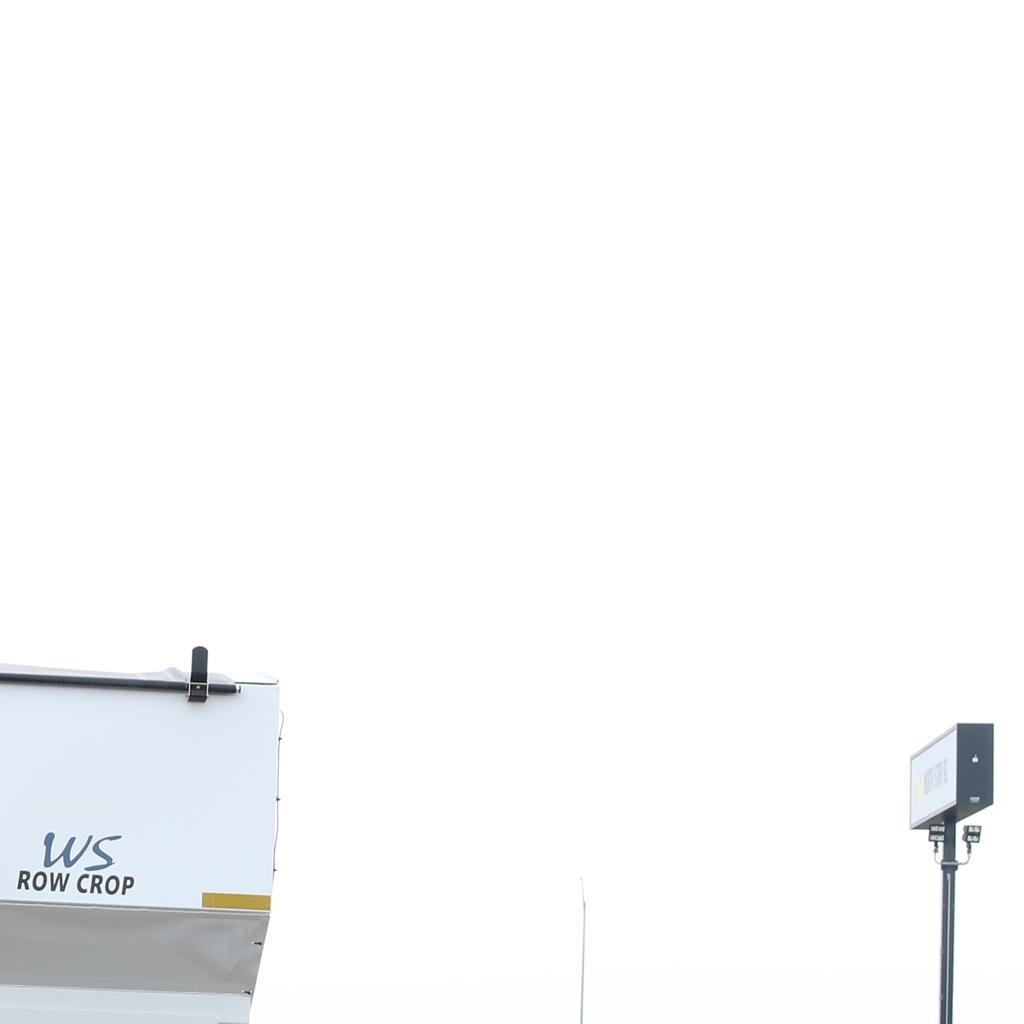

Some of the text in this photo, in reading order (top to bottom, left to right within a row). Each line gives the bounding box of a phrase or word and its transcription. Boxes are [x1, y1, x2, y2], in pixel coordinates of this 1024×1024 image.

[43, 831, 123, 872] WS
[16, 870, 135, 896] ROW CROP
